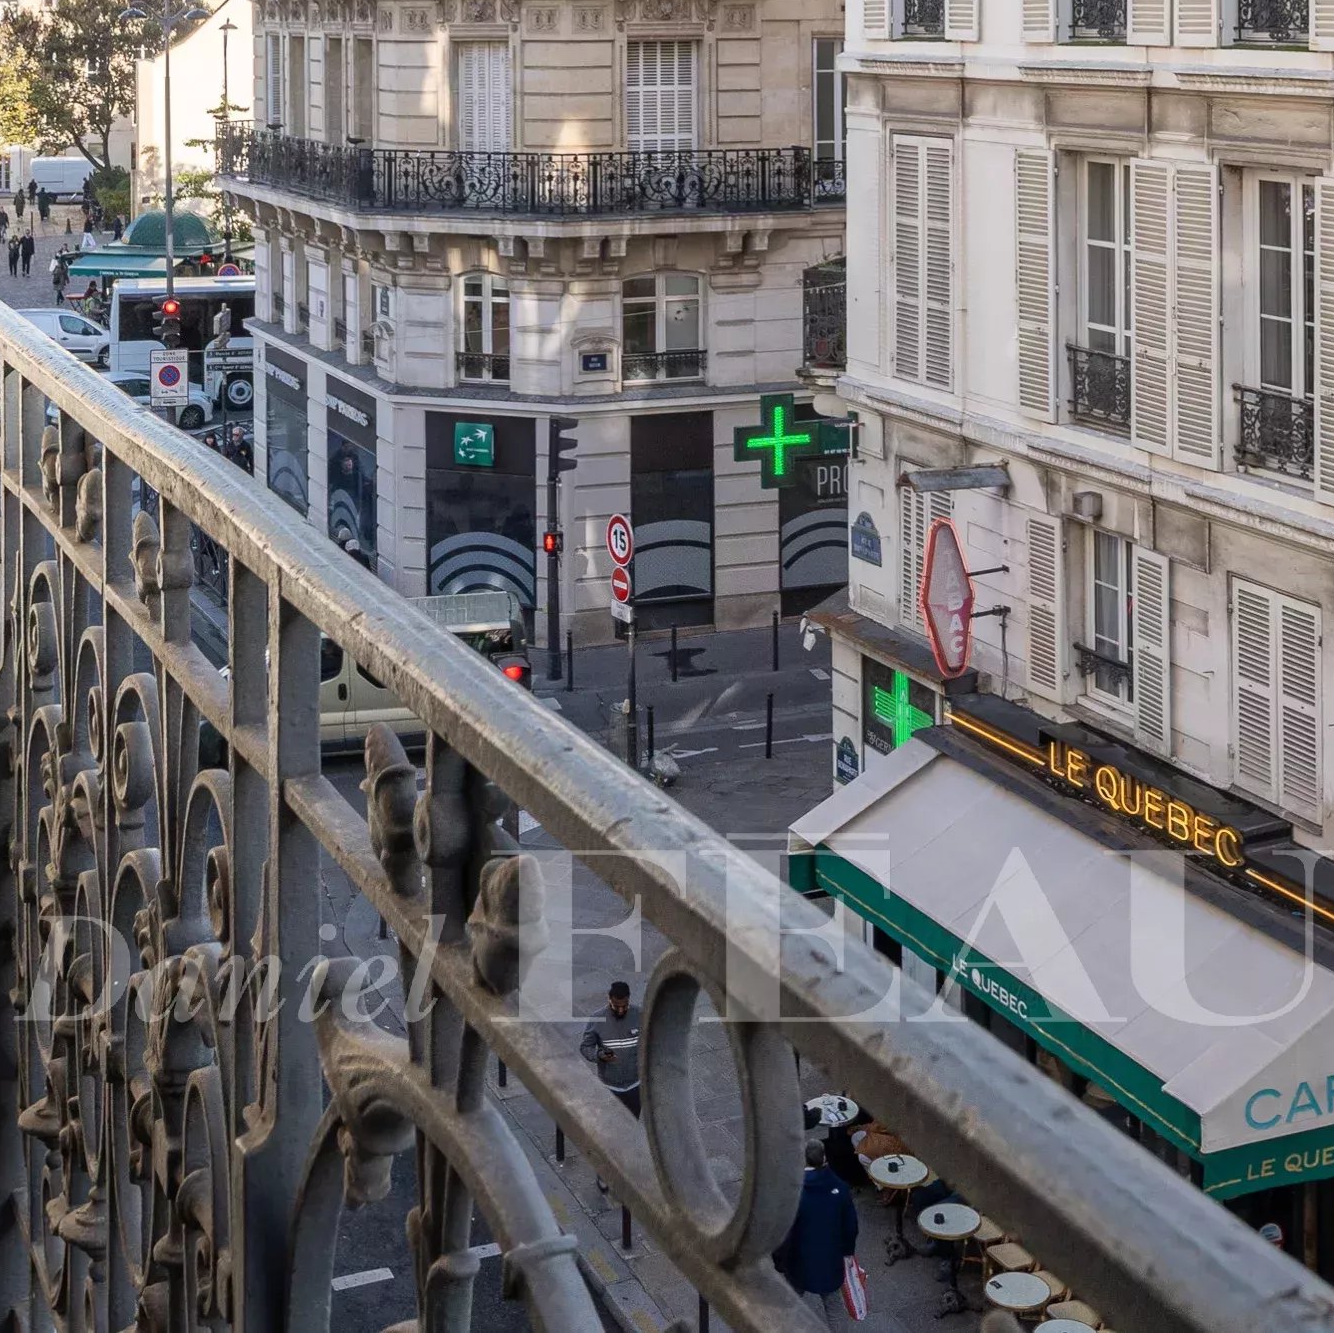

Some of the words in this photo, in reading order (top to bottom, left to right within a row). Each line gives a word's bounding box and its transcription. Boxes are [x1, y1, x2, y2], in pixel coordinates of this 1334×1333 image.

[613, 528, 627, 552] 15
[943, 548, 964, 654] TABAC
[1050, 741, 1086, 788] LE
[1095, 766, 1241, 867] QUEBEC
[952, 952, 969, 979] LE
[971, 968, 1028, 1019] QUEBEC
[1246, 1158, 1276, 1181] LE
